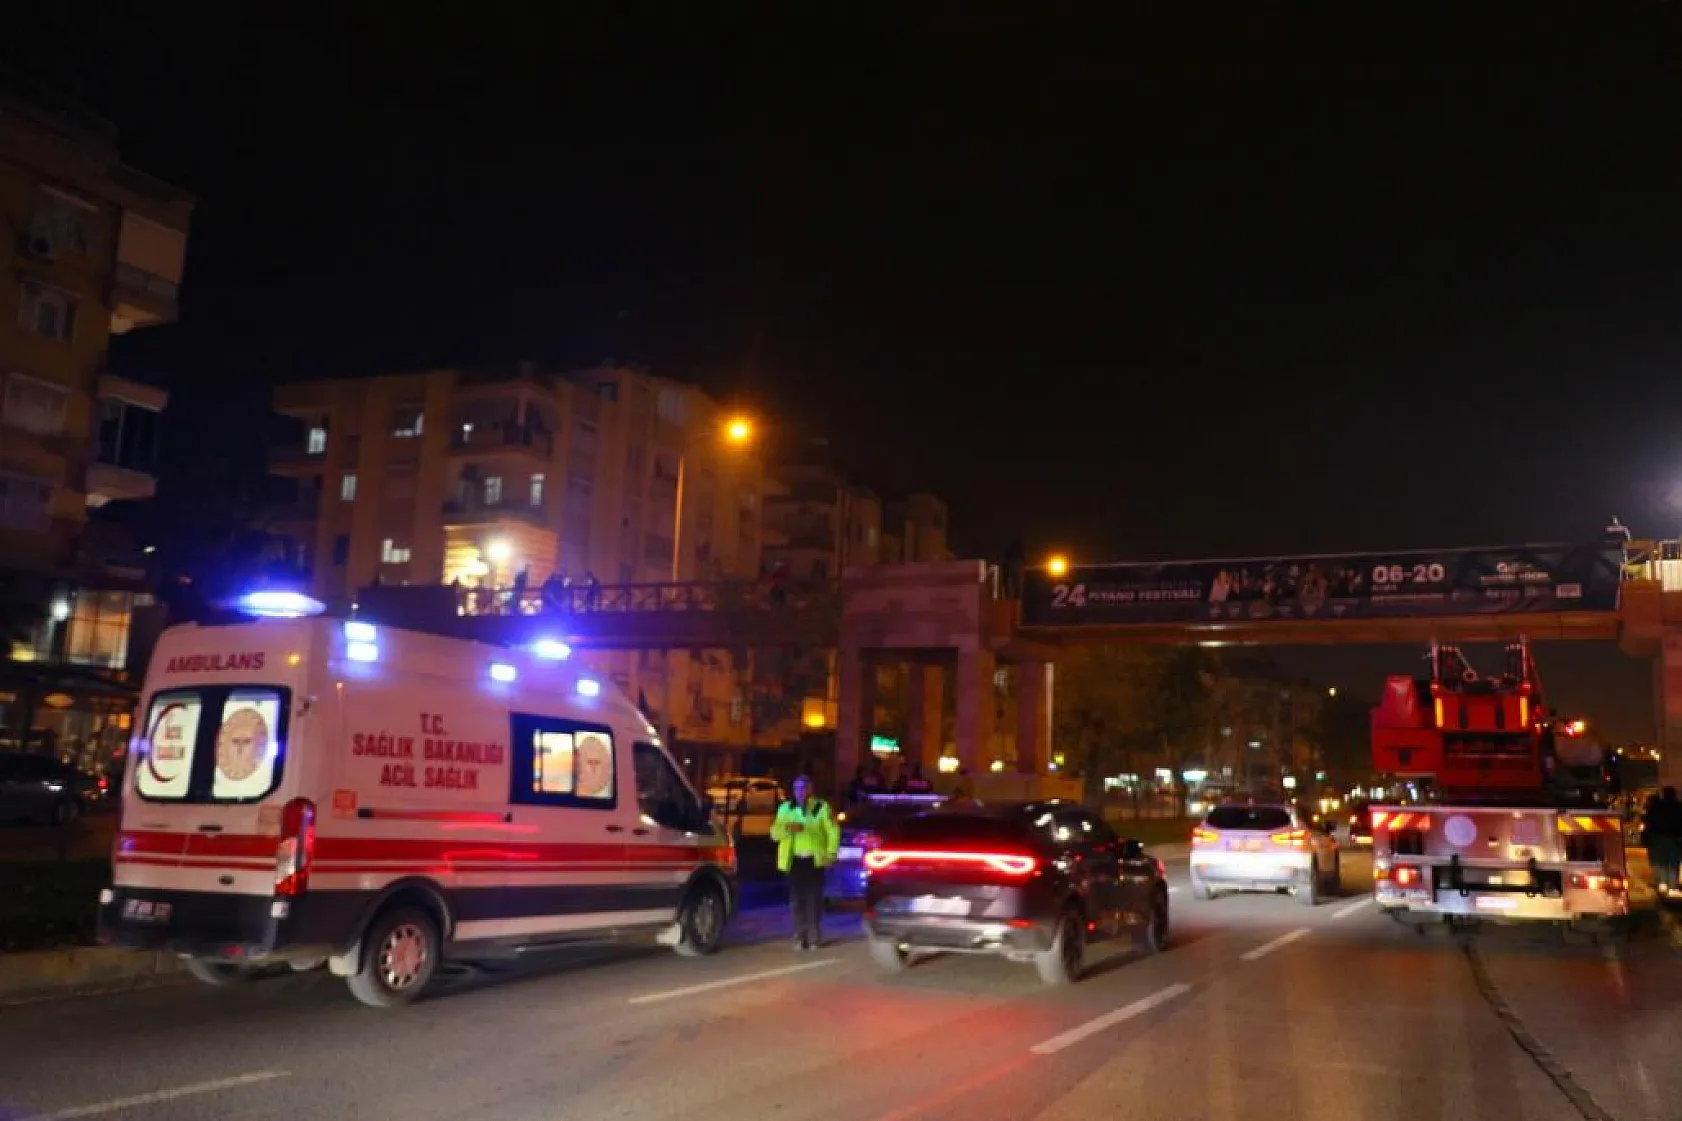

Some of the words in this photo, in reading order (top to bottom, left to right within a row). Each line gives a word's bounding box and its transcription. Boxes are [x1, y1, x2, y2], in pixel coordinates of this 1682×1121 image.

[1372, 563, 1445, 583] 06-20
[1051, 583, 1087, 608] 24
[165, 652, 265, 674] AMBULANS
[420, 713, 447, 736] T.C.
[352, 730, 414, 758] SAĞLIK
[424, 739, 504, 765] BAKANLIĞI
[379, 763, 417, 787] ACİL
[424, 767, 479, 789] SAĞLIK
